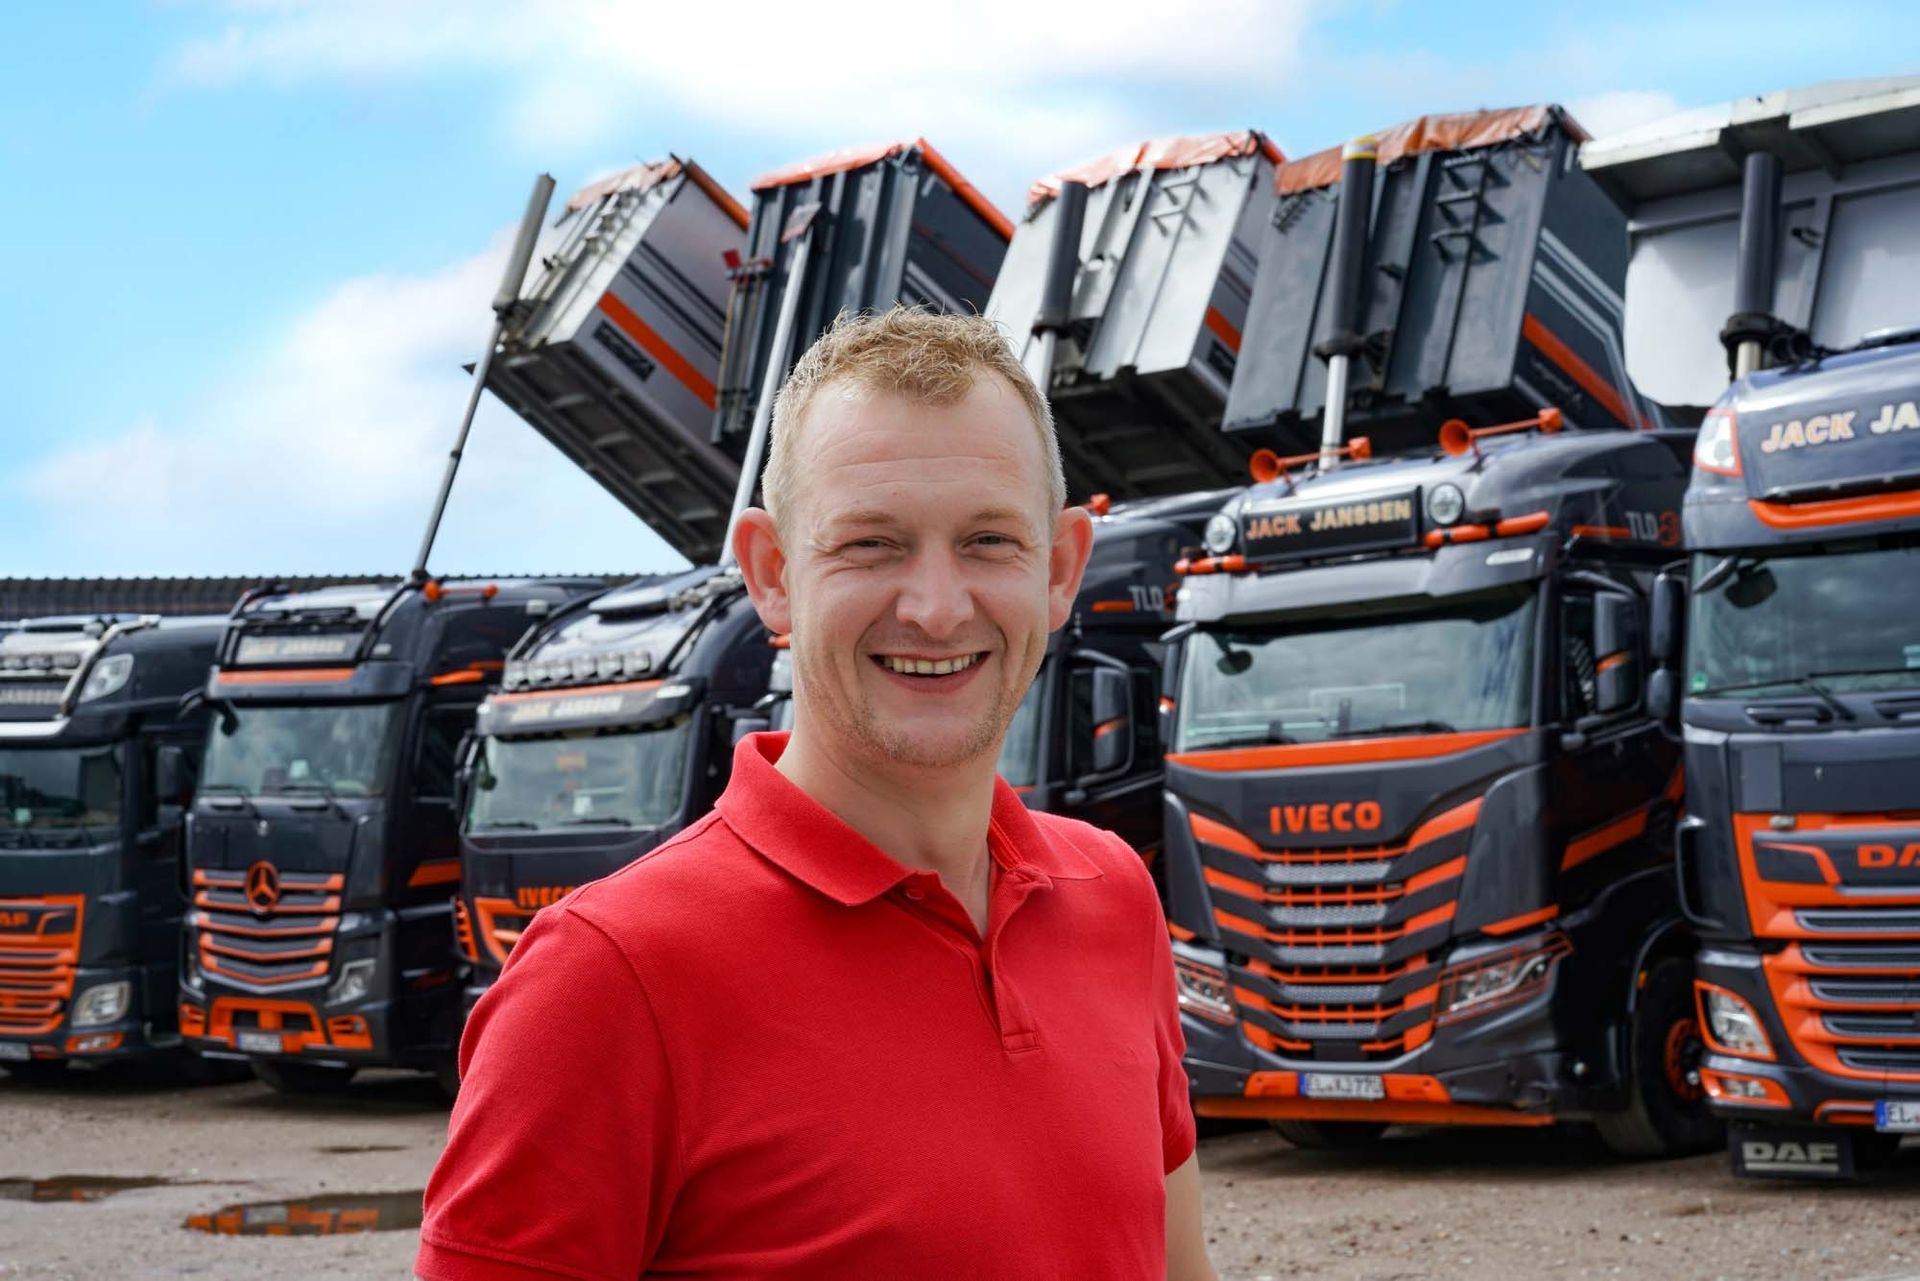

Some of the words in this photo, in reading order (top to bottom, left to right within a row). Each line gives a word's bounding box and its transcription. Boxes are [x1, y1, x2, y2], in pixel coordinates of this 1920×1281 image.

[1761, 411, 1856, 452] JACK
[1246, 514, 1302, 540] JACK
[1309, 500, 1411, 531] JANSSEN
[1270, 802, 1381, 834] IVECO
[1742, 1142, 1838, 1160] DAF
